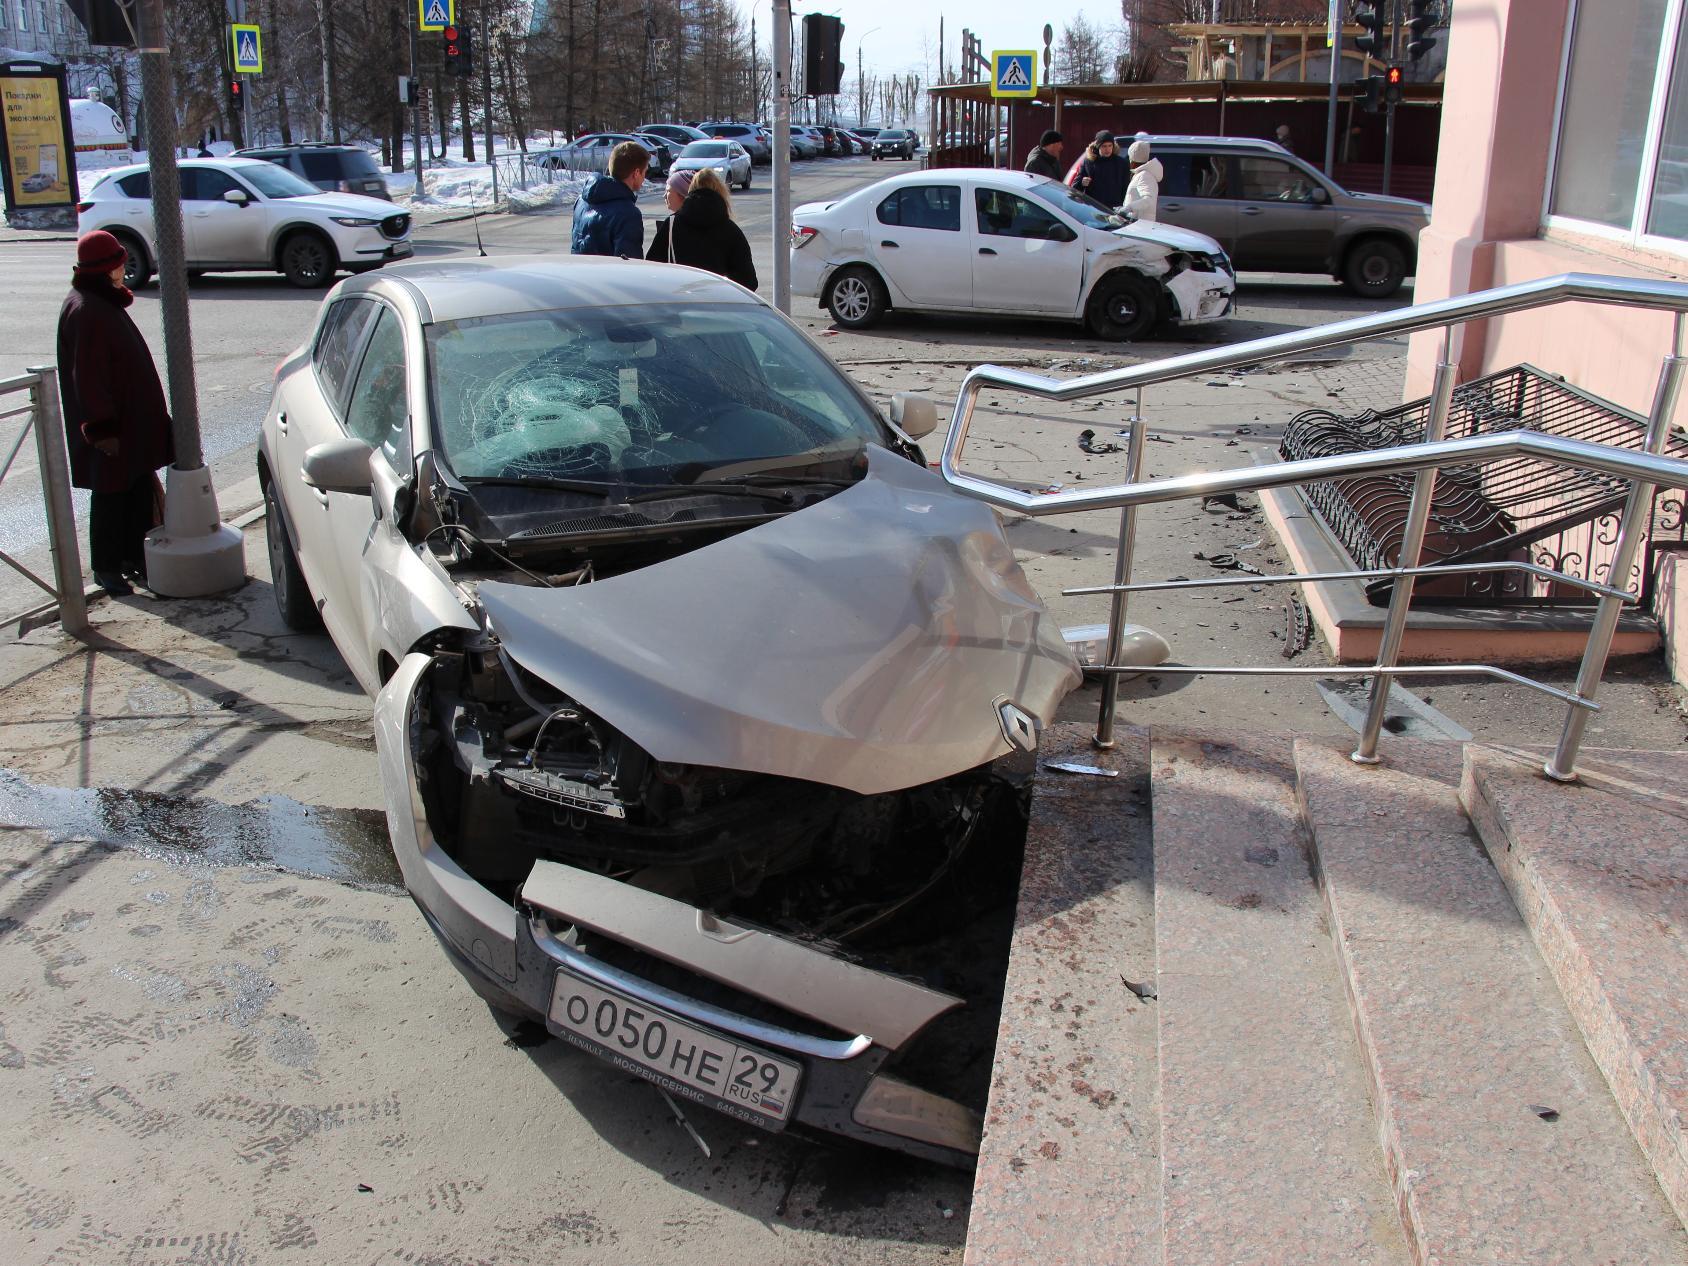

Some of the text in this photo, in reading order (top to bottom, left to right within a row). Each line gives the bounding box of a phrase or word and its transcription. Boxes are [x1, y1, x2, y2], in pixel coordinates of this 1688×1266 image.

[7, 104, 23, 112] для
[9, 114, 56, 122] экономных
[568, 1034, 602, 1056] RENAULT
[613, 1055, 705, 1103] МОСРЕНТСЕРВИС
[734, 1054, 779, 1093] 29
[729, 1084, 760, 1104] RUS
